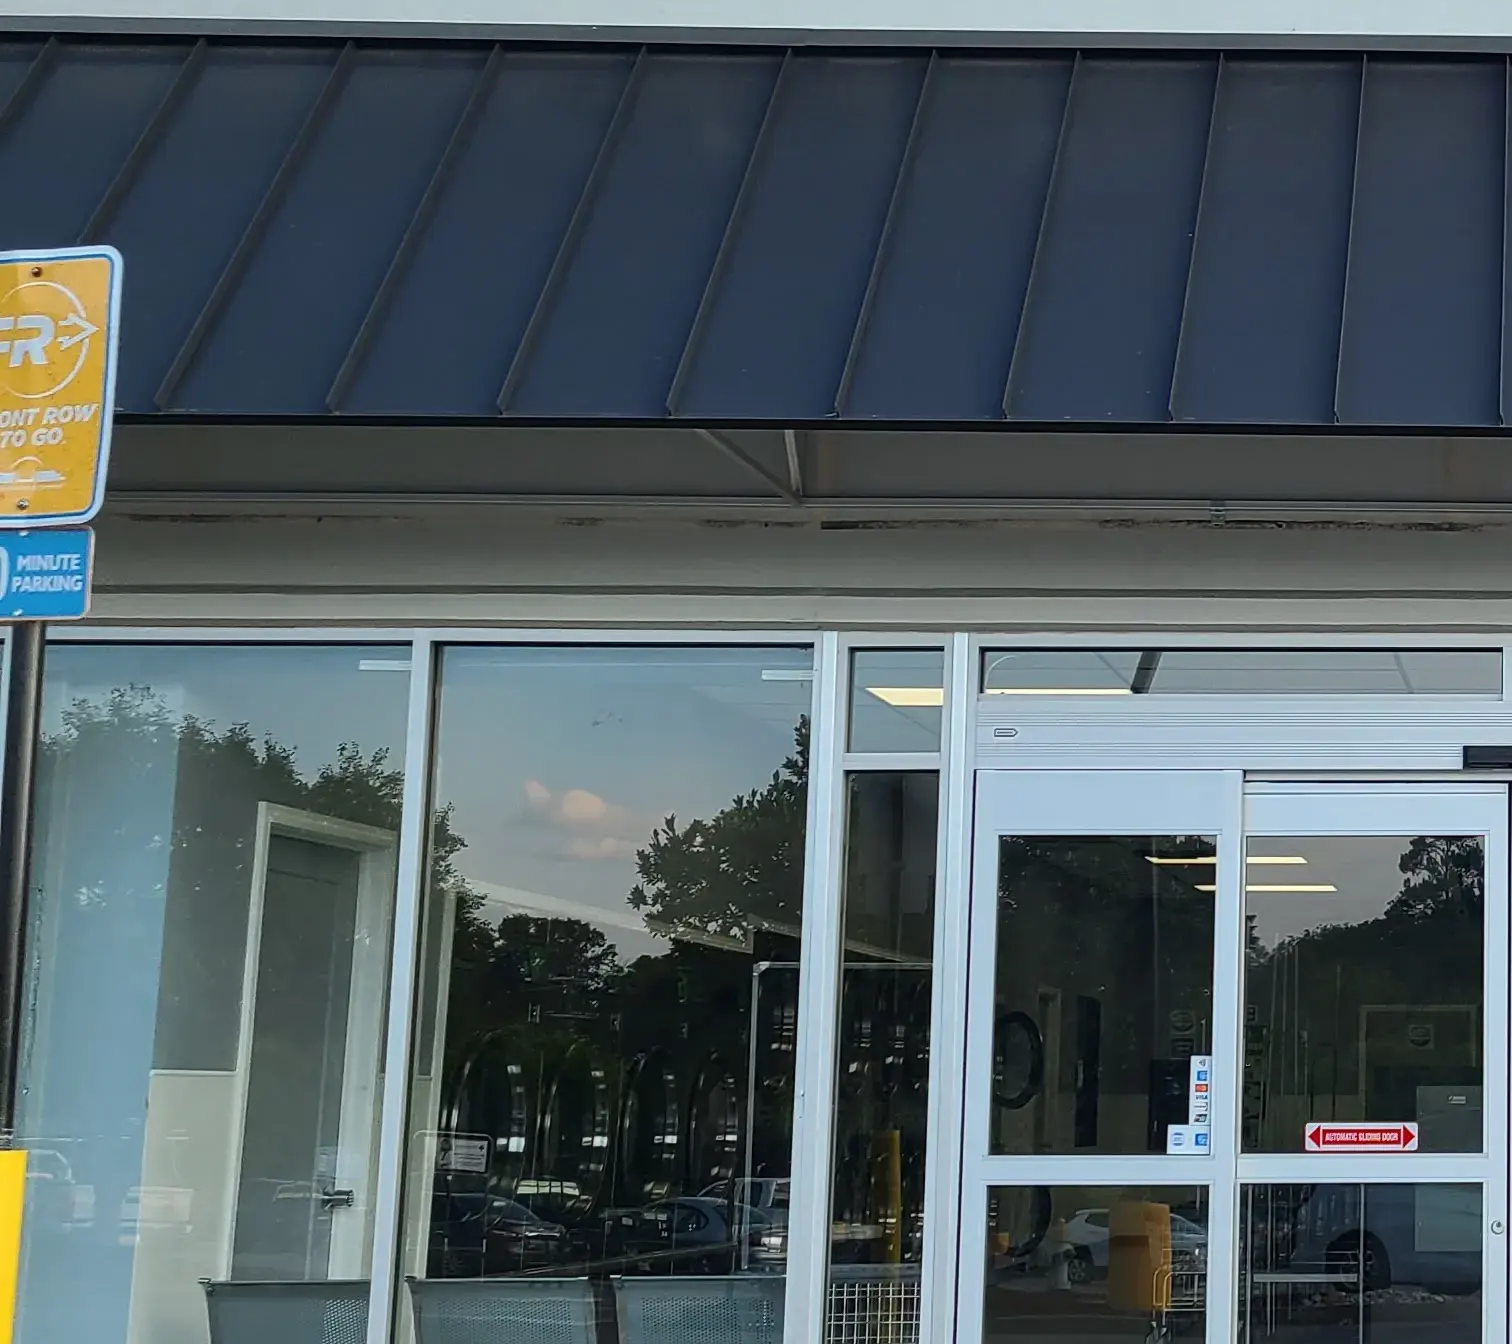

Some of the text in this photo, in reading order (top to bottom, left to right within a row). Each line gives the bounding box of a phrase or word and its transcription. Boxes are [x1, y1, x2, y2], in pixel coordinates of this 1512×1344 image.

[42, 404, 98, 425] ROW
[0, 427, 64, 447] TO GO
[17, 554, 80, 571] MINUTE
[11, 575, 84, 592] PARKING
